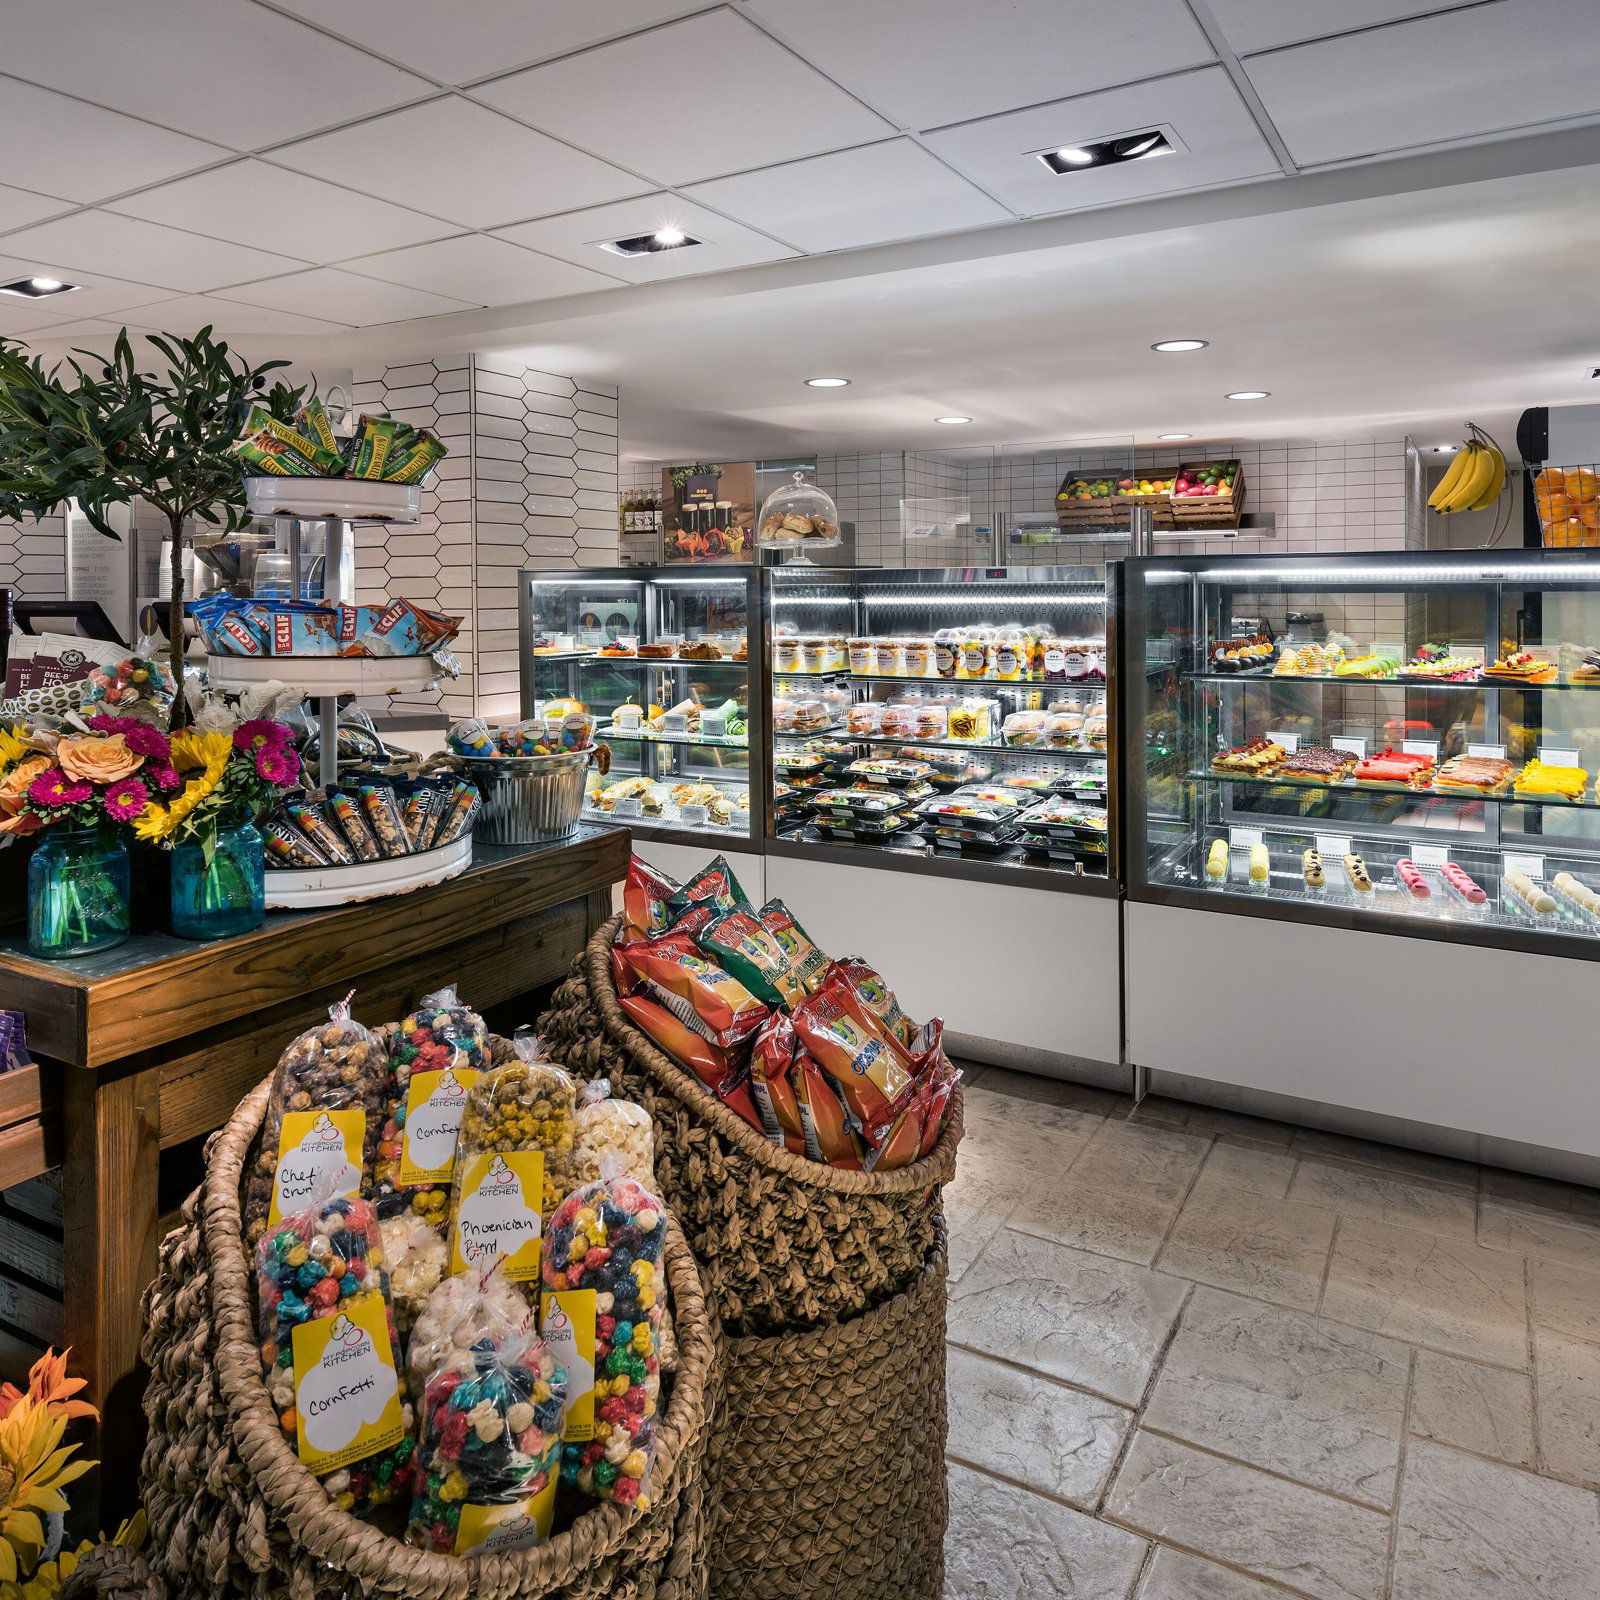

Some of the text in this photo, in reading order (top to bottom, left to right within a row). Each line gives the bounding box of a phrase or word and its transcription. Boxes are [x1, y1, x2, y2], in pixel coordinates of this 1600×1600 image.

[268, 421, 292, 441] NATURE
[291, 434, 316, 458] VALLEY
[260, 457, 286, 476] ALLEY
[284, 451, 301, 465] Honey
[368, 436, 389, 479] NATURE VALLE
[342, 608, 357, 632] CLIF
[381, 605, 403, 627] CLIF
[277, 614, 291, 643] CLIF
[44, 671, 72, 680] BEE-B
[415, 789, 431, 814] KIND
[266, 822, 298, 847] KIND
[429, 1100, 467, 1108] KITCHEN
[416, 1123, 460, 1140] Cornfet
[301, 1145, 342, 1153] KITCHEN
[479, 1188, 519, 1197] KITCHEN
[460, 1219, 533, 1238] Phoenician
[322, 1346, 372, 1369] KITCHEN
[334, 1340, 371, 1356] POPCORN
[309, 1374, 375, 1416] Cornfetti
[329, 1441, 368, 1459] SCOTTSDALE
[485, 1528, 534, 1549] KITCHEN
